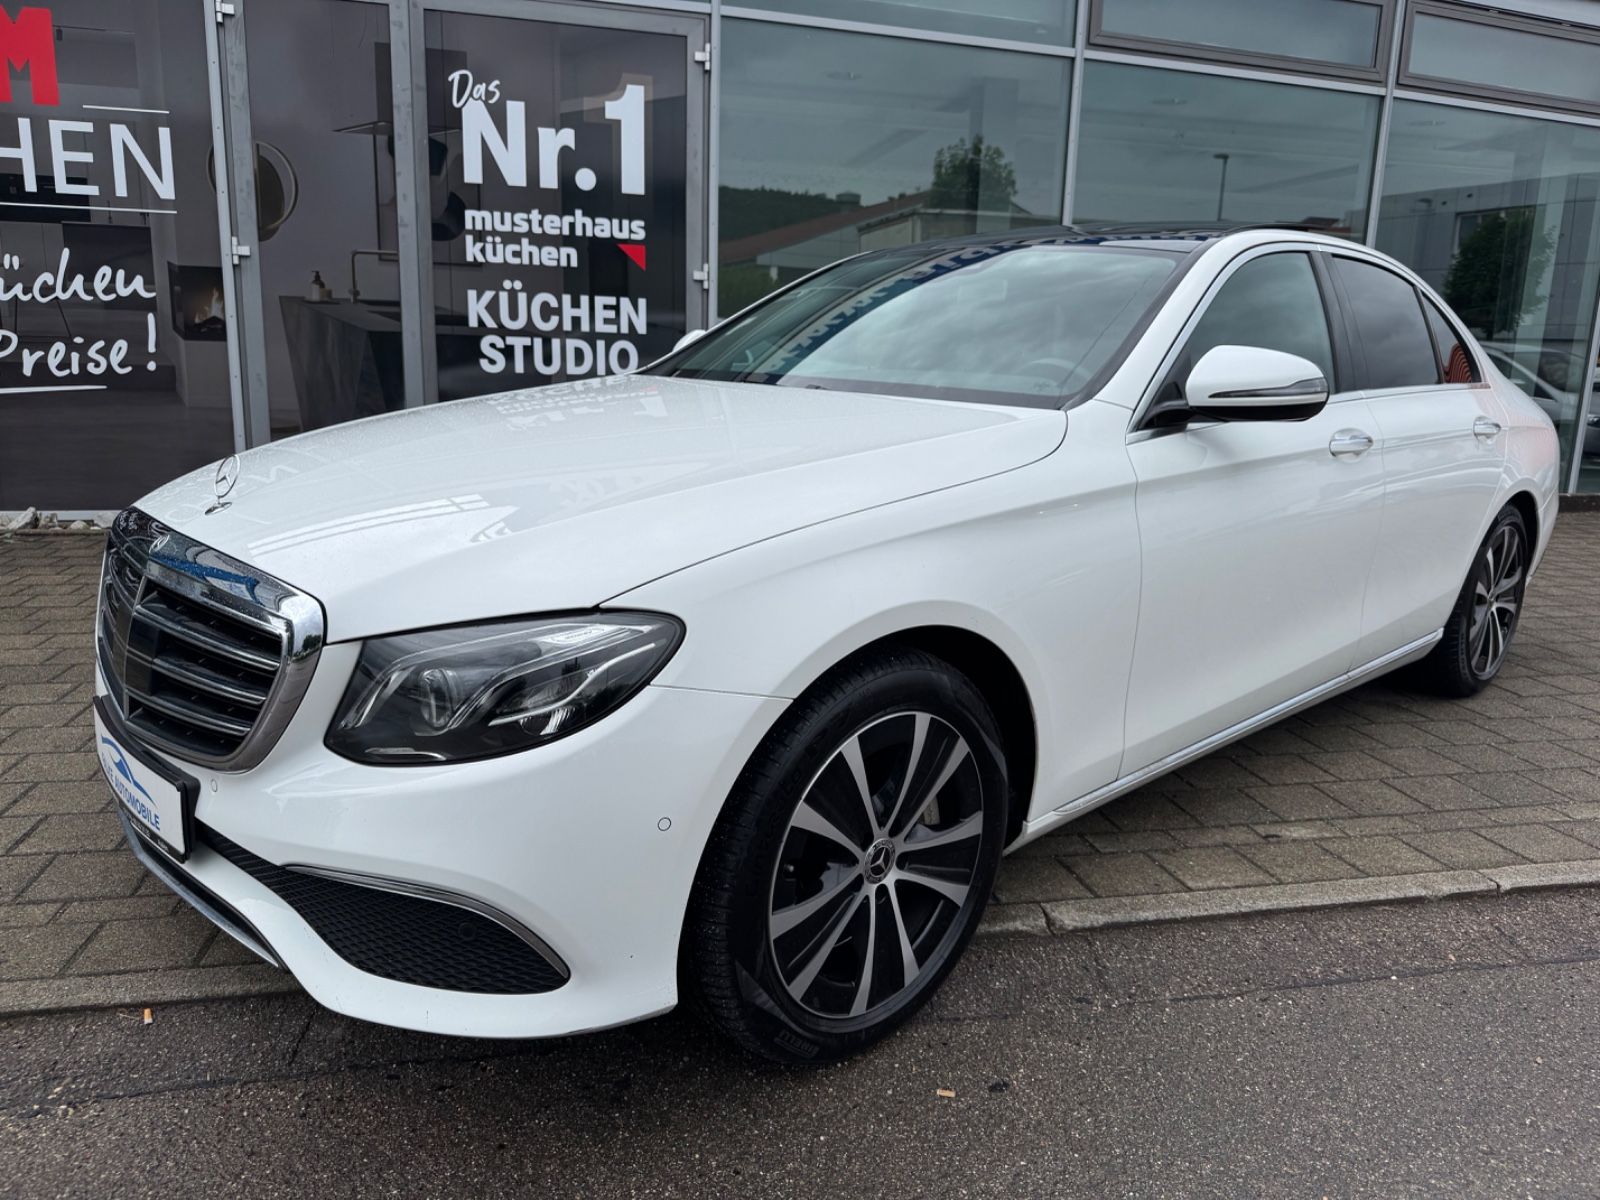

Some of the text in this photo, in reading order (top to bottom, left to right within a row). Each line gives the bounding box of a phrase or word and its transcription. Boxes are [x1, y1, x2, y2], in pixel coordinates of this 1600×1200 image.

[448, 69, 501, 108] Das
[464, 208, 646, 241] musterhaus
[464, 234, 578, 268] küchen
[466, 279, 648, 335] KÜCHEN
[479, 334, 639, 376] STUDIO
[115, 779, 161, 831] AUTOMOBILE
